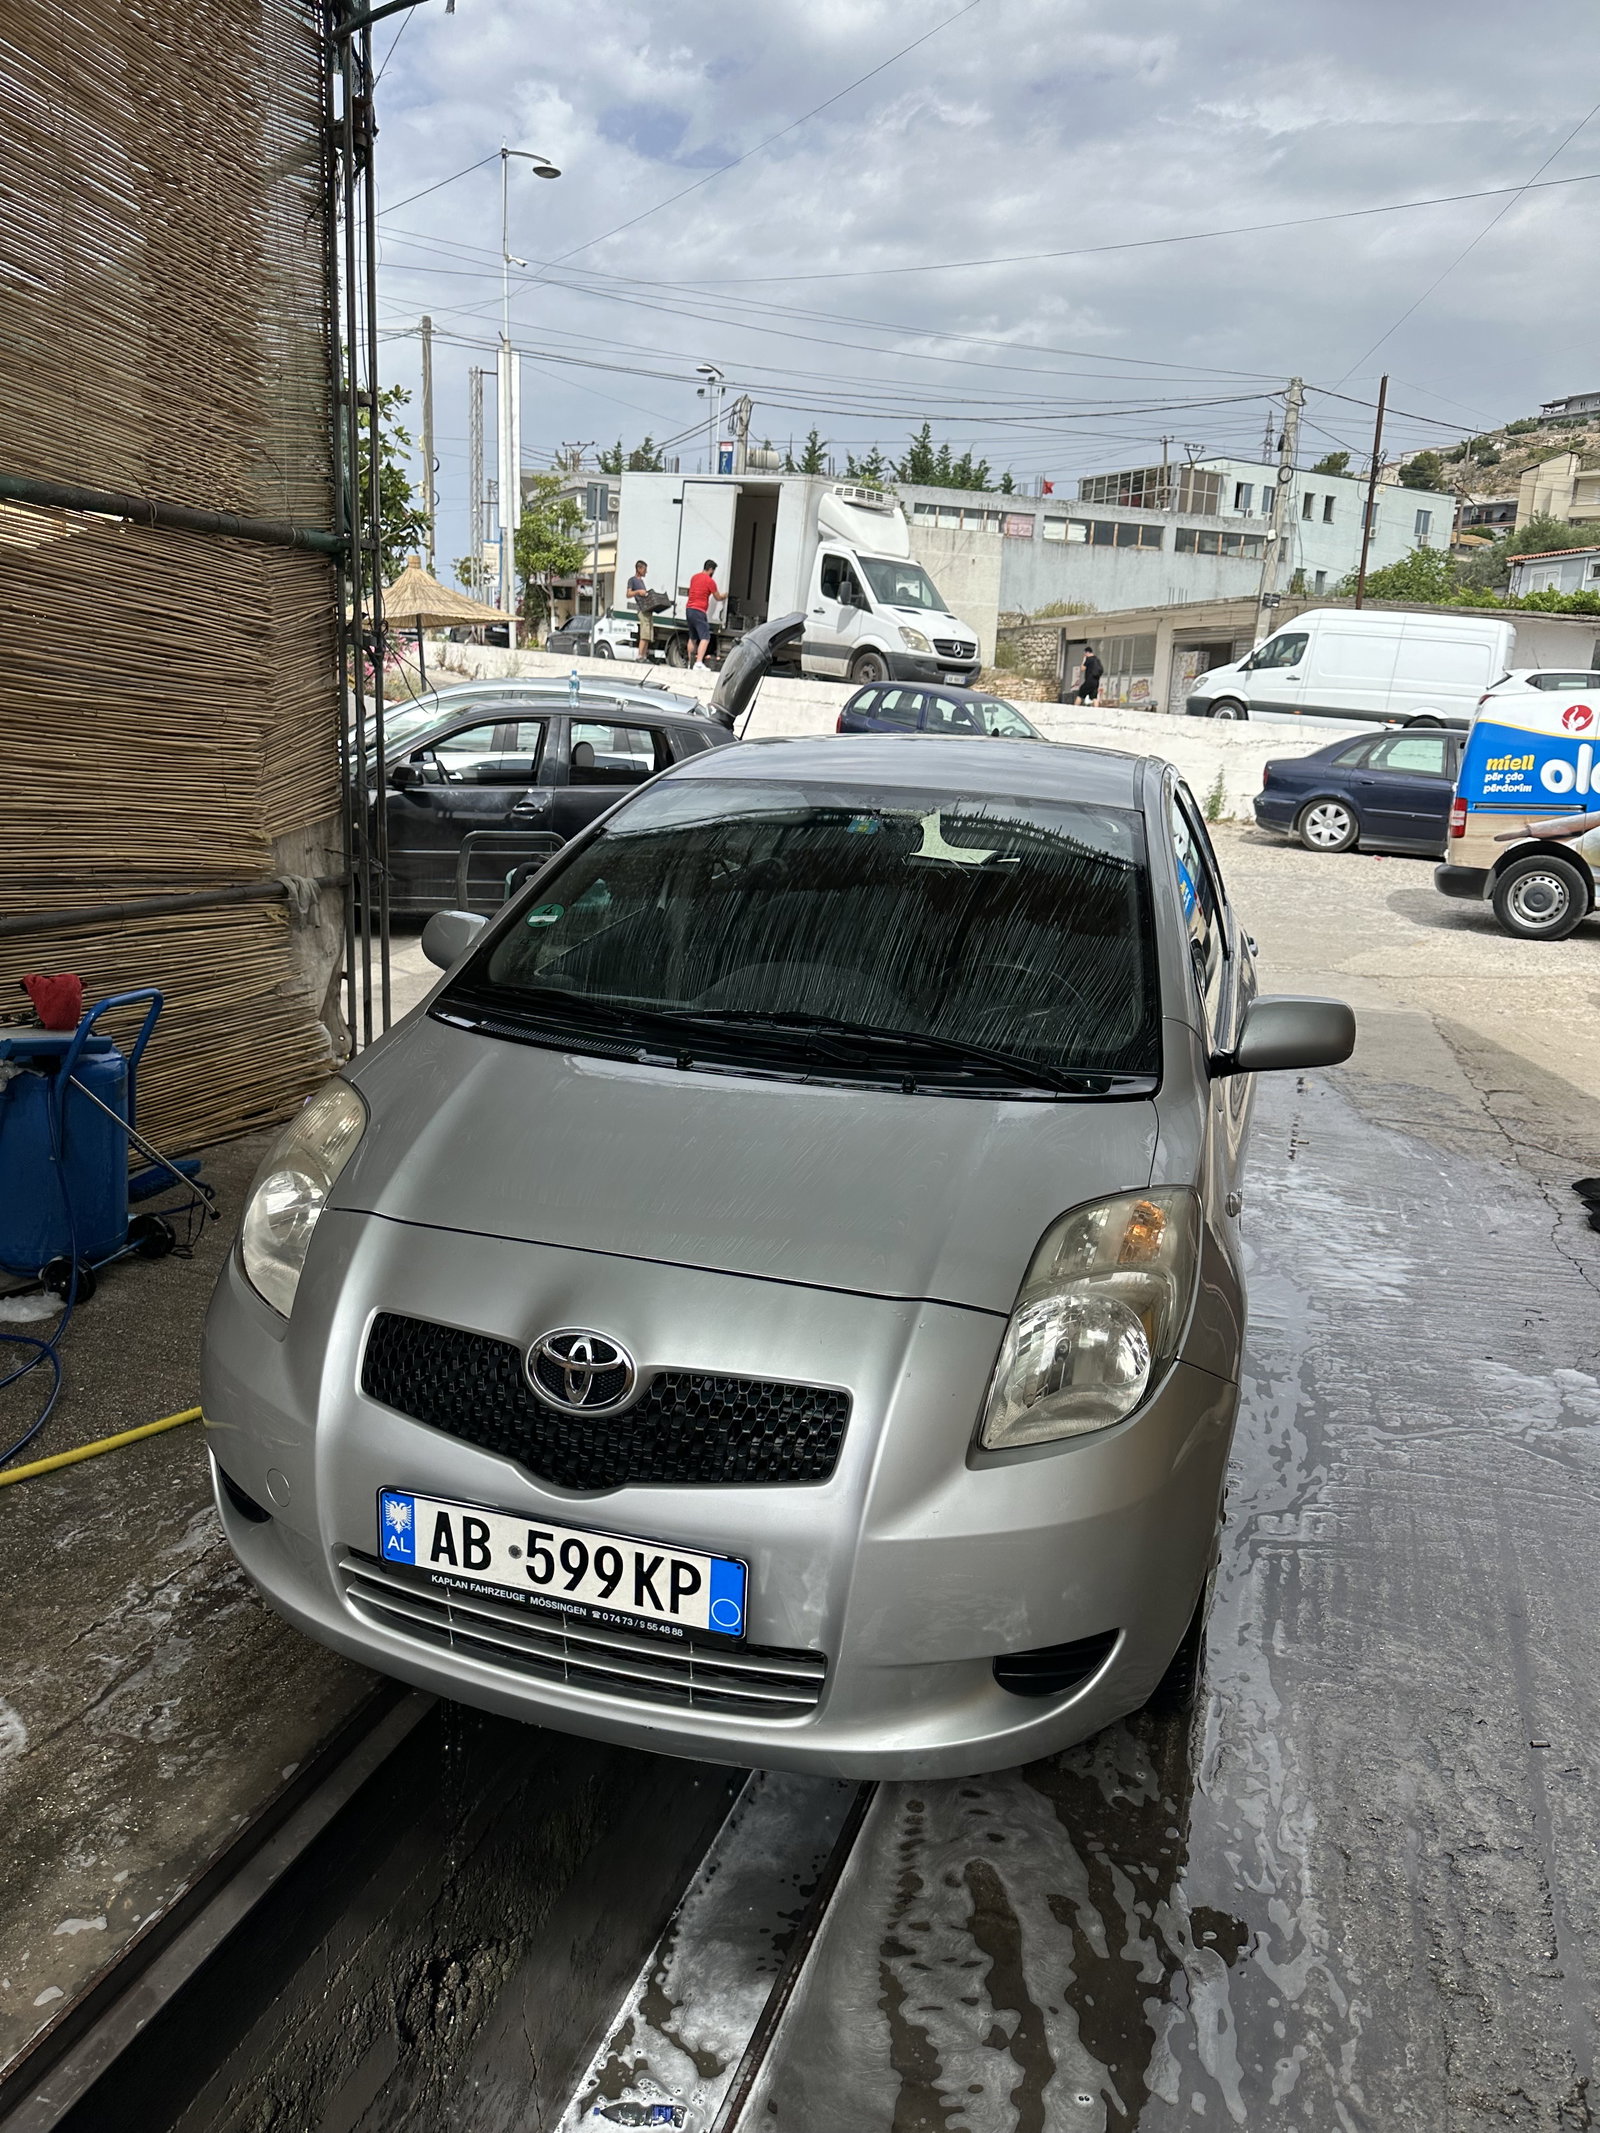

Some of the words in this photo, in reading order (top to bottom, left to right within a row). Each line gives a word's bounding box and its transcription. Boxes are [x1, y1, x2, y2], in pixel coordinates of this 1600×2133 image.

[1486, 754, 1535, 771] miell
[1540, 743, 1600, 795] ol
[543, 904, 554, 915] 4
[387, 1536, 411, 1553] AL
[430, 1511, 492, 1571] AB
[431, 1574, 468, 1590] KAPLAN
[470, 1583, 526, 1603] FAHRZEUGE
[530, 1596, 587, 1616] MÖSSINGEN
